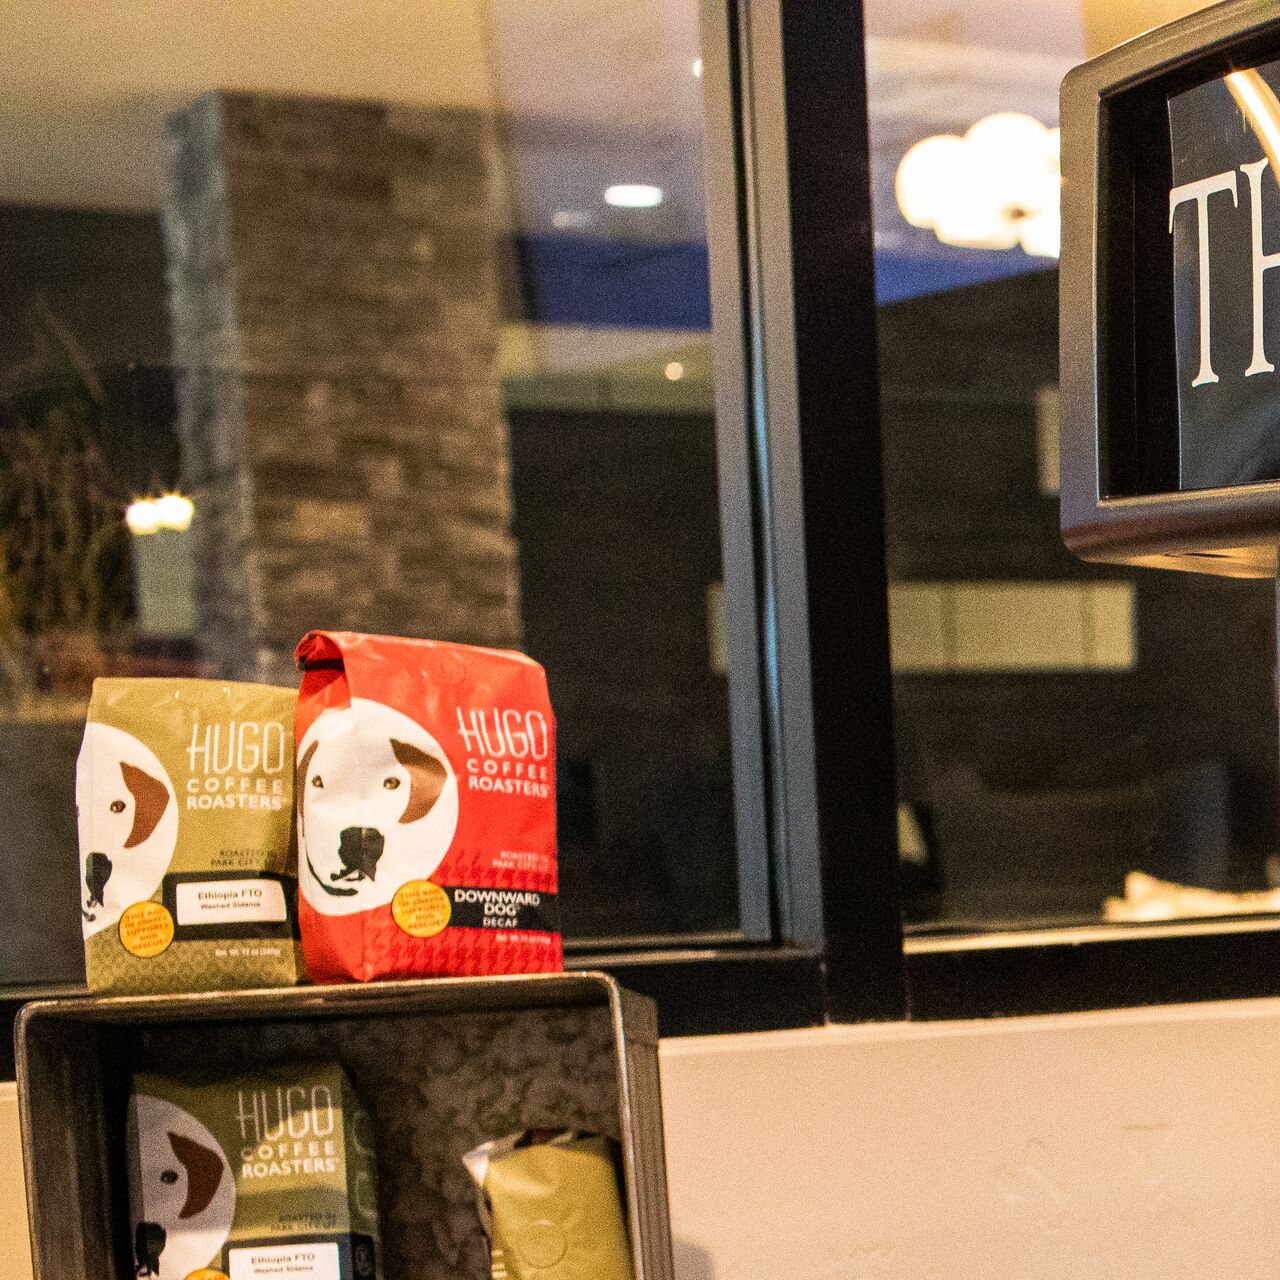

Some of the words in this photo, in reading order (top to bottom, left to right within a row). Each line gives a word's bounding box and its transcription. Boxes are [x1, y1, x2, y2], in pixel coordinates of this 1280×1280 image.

[457, 706, 548, 760] HUGO
[187, 720, 284, 774] HUGO
[467, 759, 548, 779] COFFEE
[187, 777, 282, 796] COFFEE
[469, 777, 548, 798] ROASTERS
[187, 795, 282, 811] ROASTERS
[454, 889, 540, 906] DOWNWARD
[483, 903, 517, 917] DOG
[237, 1085, 335, 1143] HUGO
[242, 1140, 335, 1162] COFFEE
[242, 1158, 336, 1179] ROASTERS
